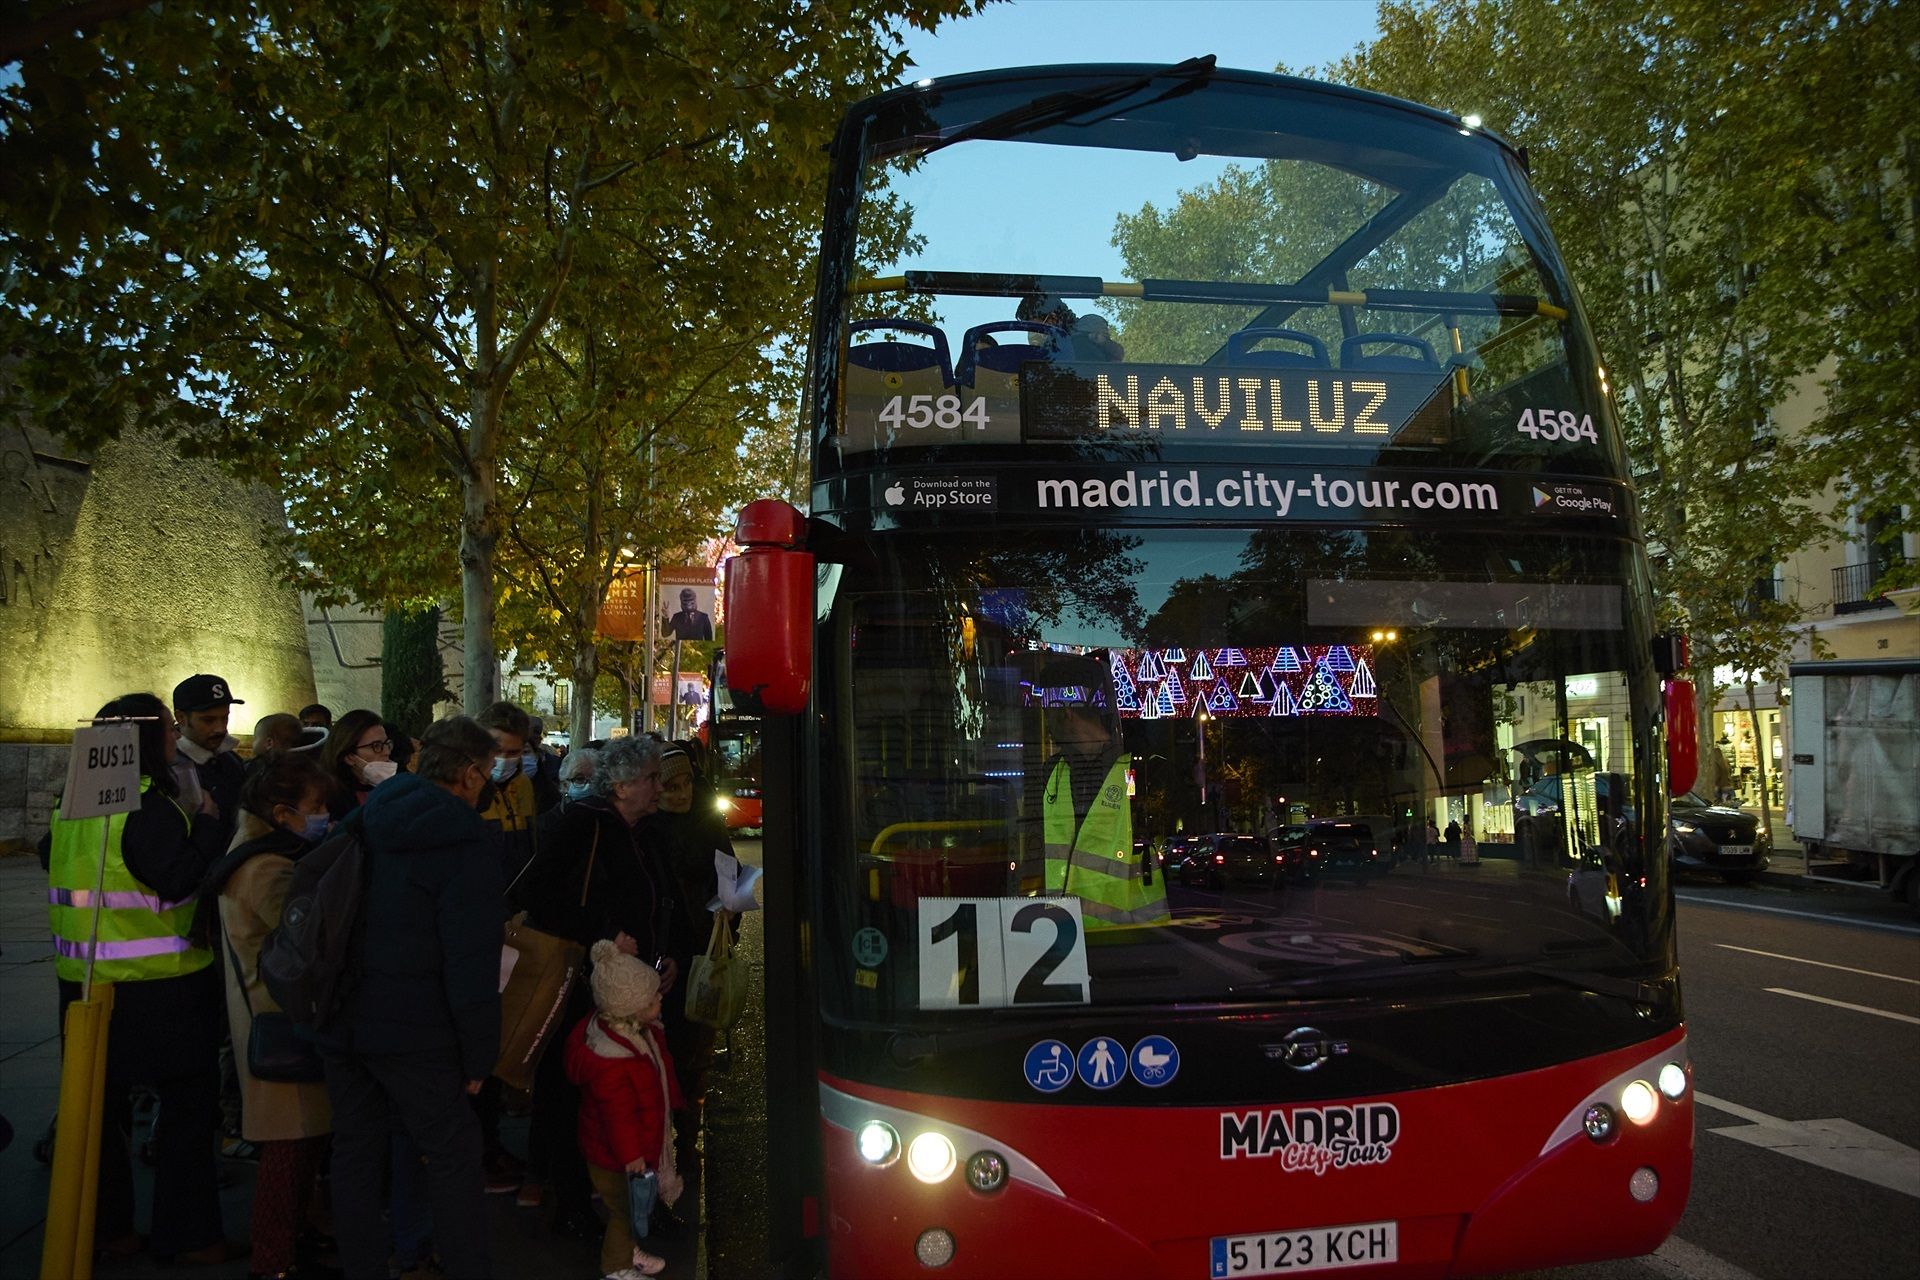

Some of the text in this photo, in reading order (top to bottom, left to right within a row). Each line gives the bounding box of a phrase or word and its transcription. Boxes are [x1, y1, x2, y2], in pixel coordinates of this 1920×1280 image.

[878, 394, 990, 430] 4584
[1097, 374, 1389, 434] NAVILUZ
[1516, 408, 1598, 445] 4584
[913, 479, 991, 489] Download on the
[913, 490, 992, 508] App Store
[1037, 469, 1499, 517] madrid.city-tour.com
[1555, 495, 1612, 513] Google Play
[212, 684, 224, 699] S
[88, 743, 136, 769] BUS 12
[97, 787, 127, 806] 18:10
[931, 903, 1083, 1005] 12
[1221, 1104, 1399, 1158] MADRID
[1282, 1138, 1390, 1174] City Tour
[1230, 1234, 1314, 1271] 5123
[1326, 1227, 1387, 1263] KCH
